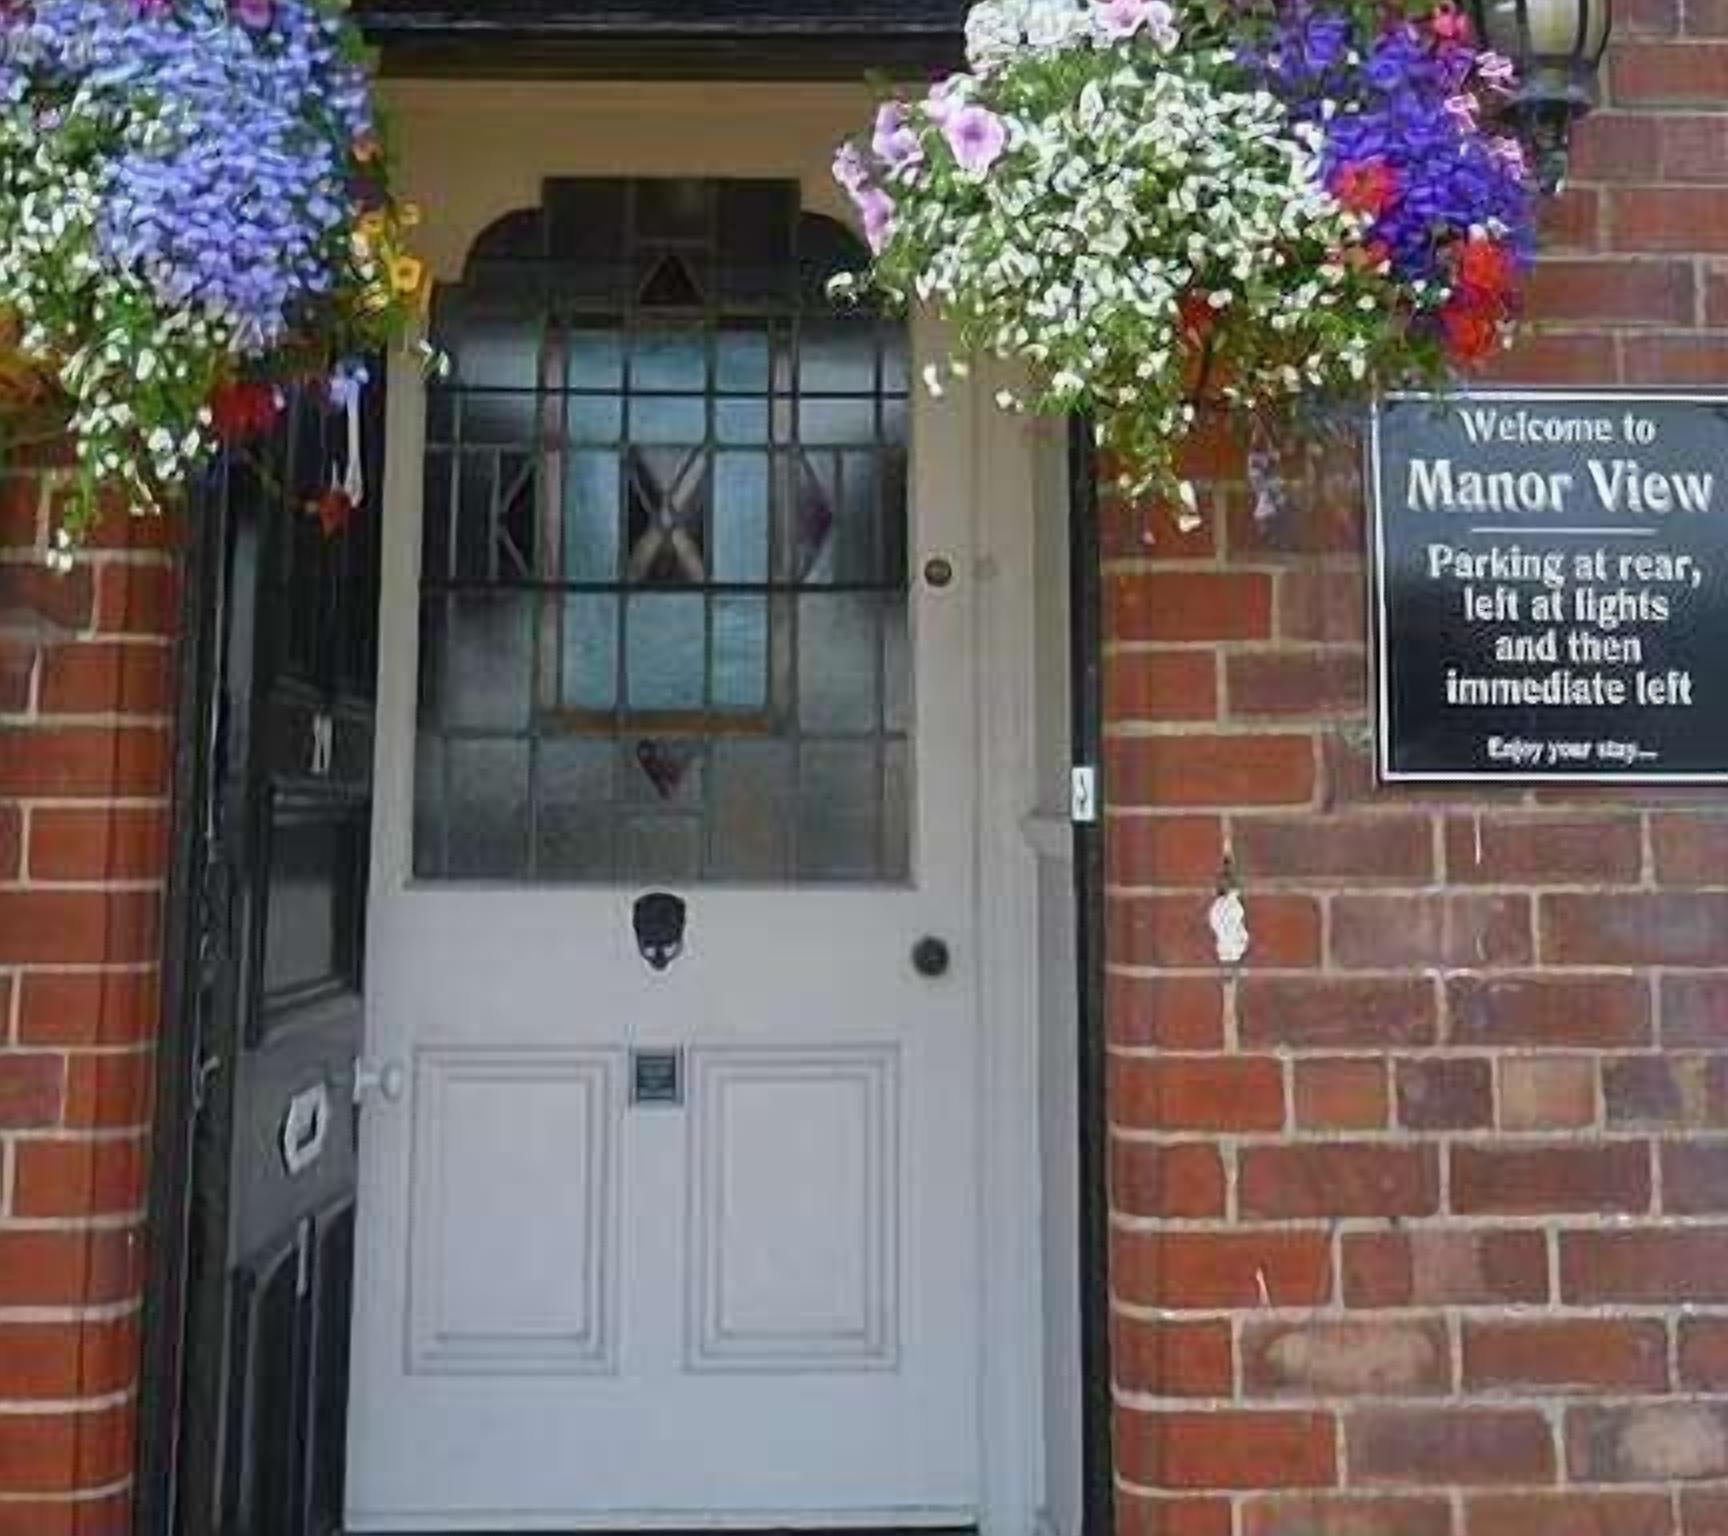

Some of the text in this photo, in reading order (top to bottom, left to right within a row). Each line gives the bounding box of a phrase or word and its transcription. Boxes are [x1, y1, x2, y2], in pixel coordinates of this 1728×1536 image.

[1459, 408, 1656, 444] Welcome to
[1407, 458, 1714, 513] Manor View
[1428, 543, 1702, 590] Parking at rear,
[1464, 586, 1670, 630] left at lights
[1495, 627, 1643, 663] and then
[1446, 668, 1693, 706] immediate left
[1548, 742, 1592, 764] your
